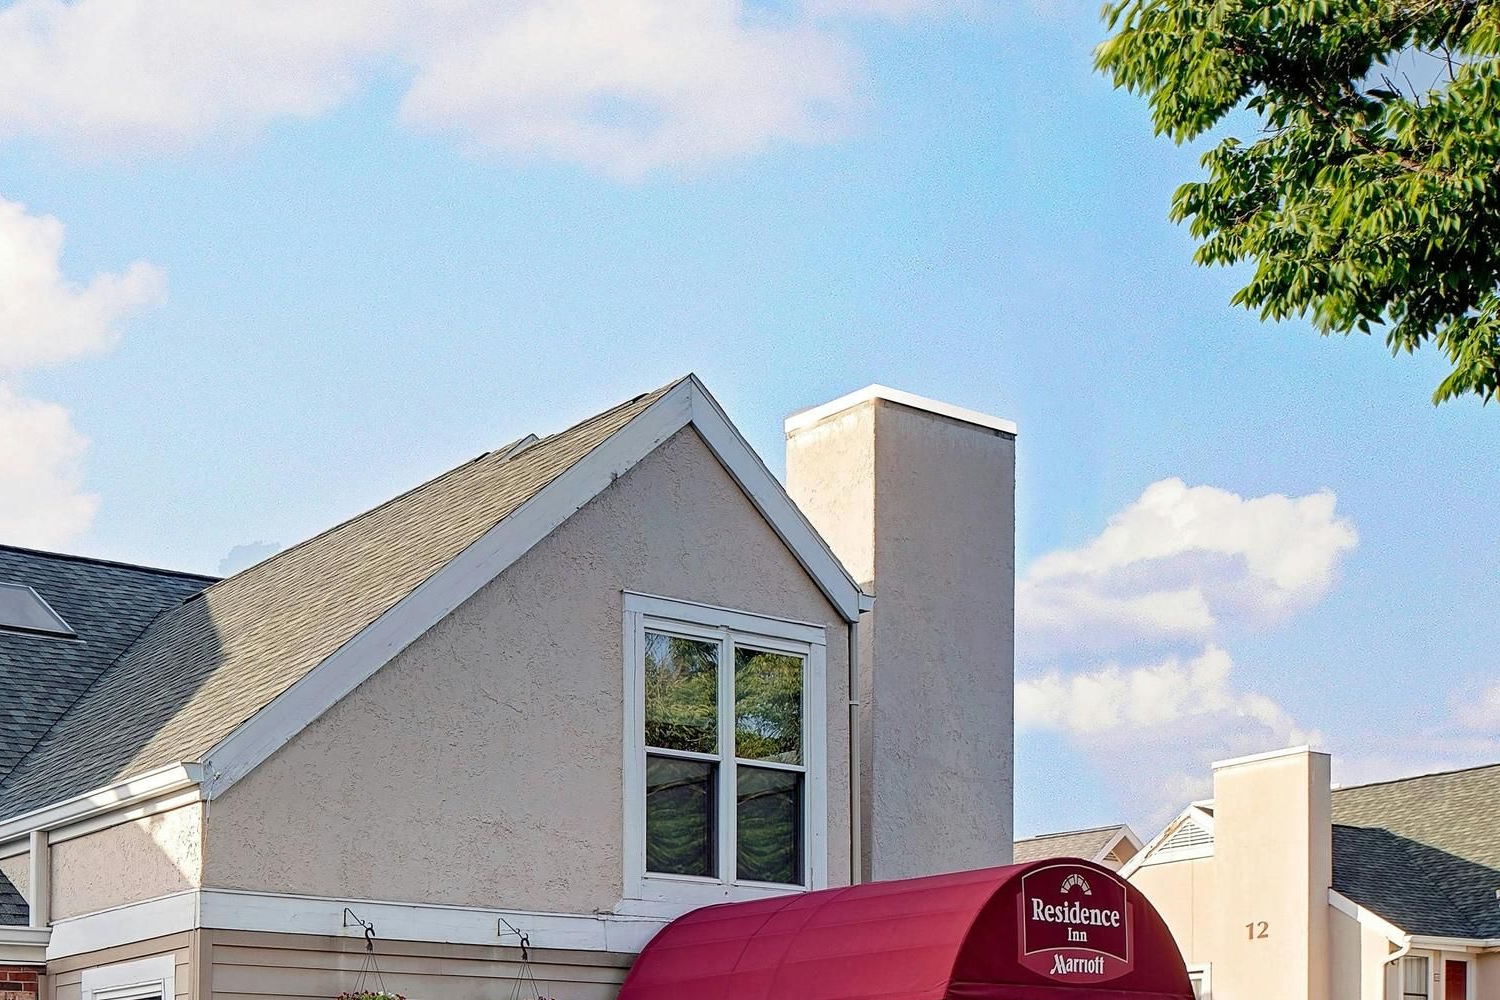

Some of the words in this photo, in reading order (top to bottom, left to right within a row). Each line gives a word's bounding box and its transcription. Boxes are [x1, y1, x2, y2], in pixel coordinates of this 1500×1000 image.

[1031, 897, 1120, 928] Residence
[1067, 927, 1088, 942] Inn
[1245, 921, 1269, 940] 12
[1049, 953, 1105, 975] Marriott
